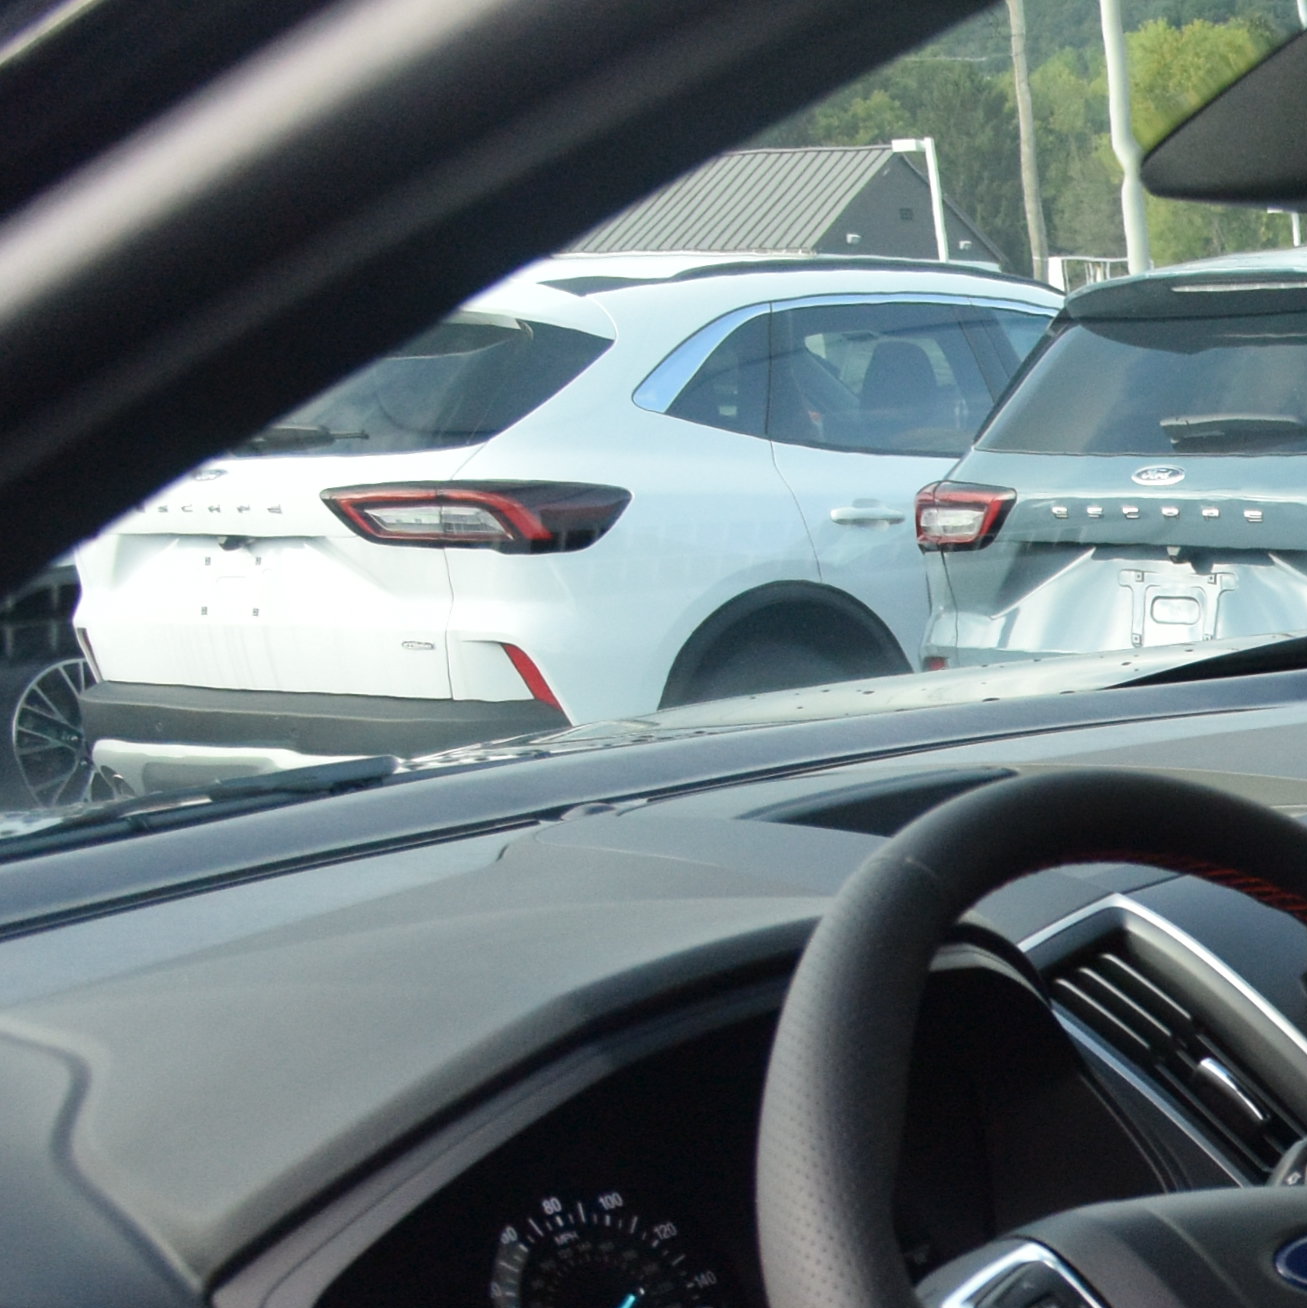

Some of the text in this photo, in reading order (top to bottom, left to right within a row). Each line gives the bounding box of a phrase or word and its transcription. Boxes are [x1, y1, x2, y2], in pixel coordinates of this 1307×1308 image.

[1051, 504, 1264, 524] ESCAPE
[541, 1197, 562, 1215] 80
[598, 1192, 624, 1211] 100
[652, 1222, 678, 1241] 120
[694, 1271, 718, 1289] 140
